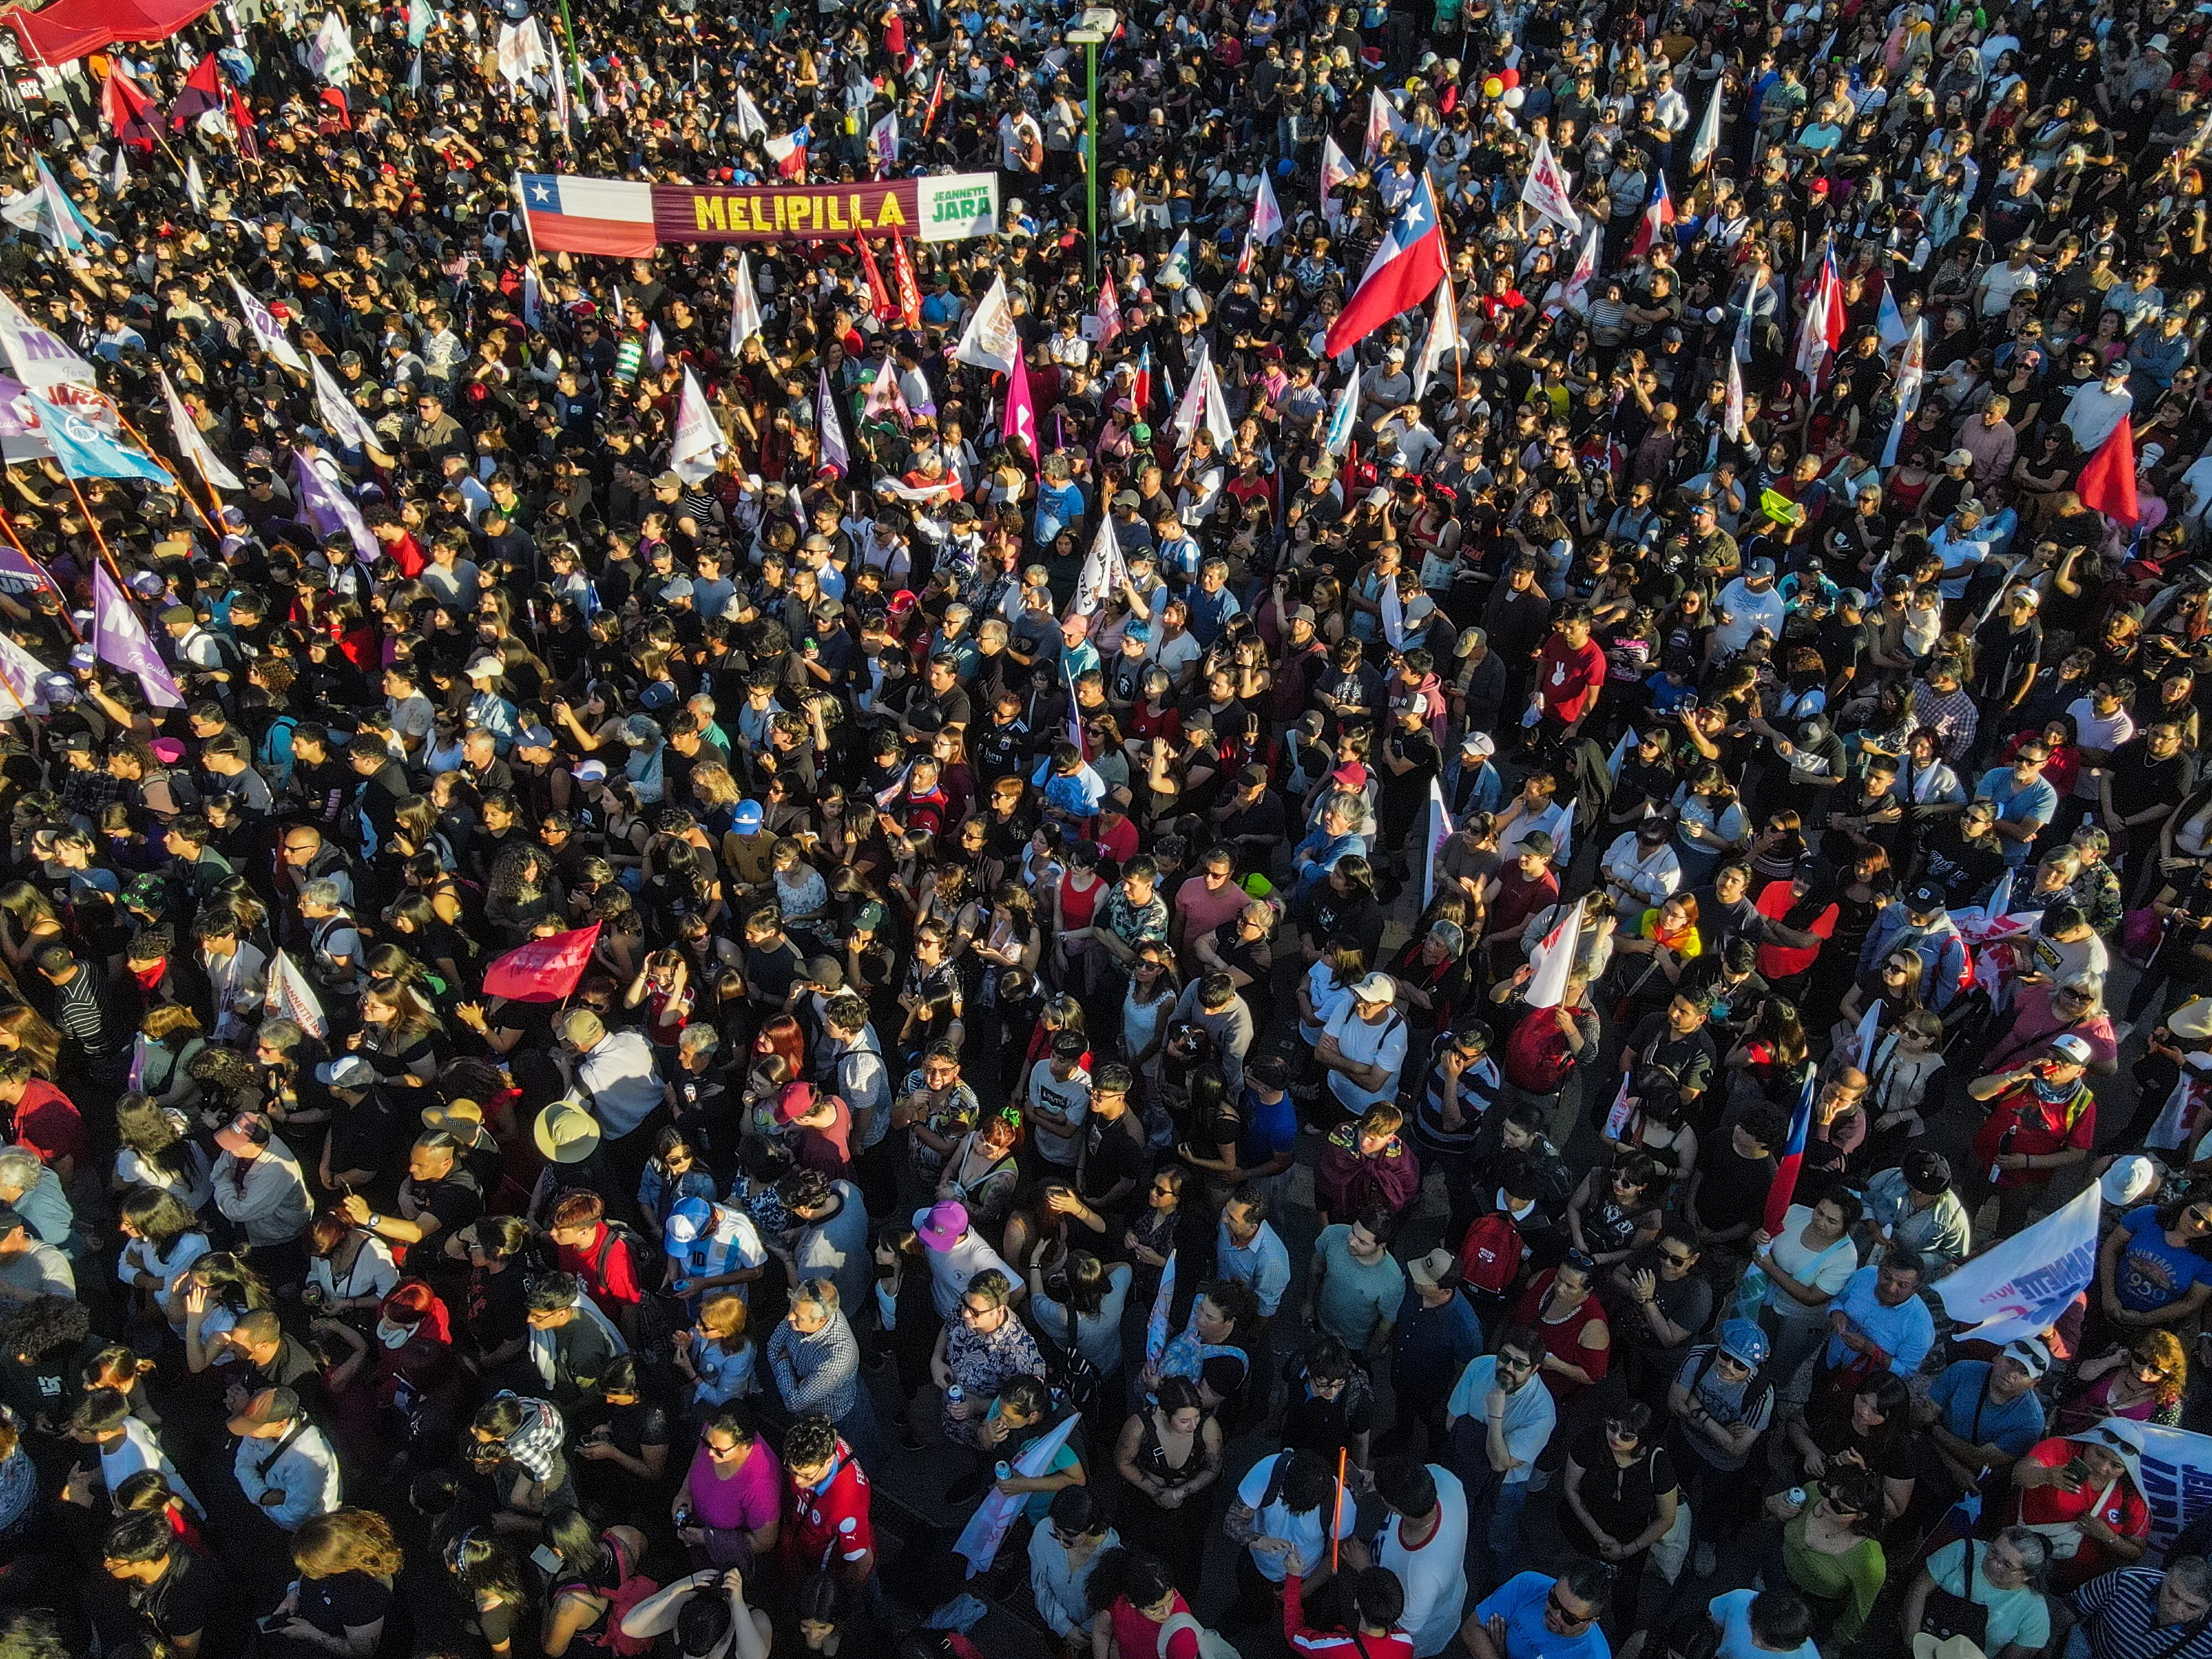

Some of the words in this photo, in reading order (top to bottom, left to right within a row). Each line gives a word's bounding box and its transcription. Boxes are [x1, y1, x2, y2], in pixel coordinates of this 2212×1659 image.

[933, 186, 988, 202] JEANNETTE
[694, 192, 906, 231] MELIPILLA
[932, 197, 992, 222] JARA
[48, 385, 108, 408] JARA
[92, 412, 101, 420] 2
[1080, 568, 1089, 599] OTA
[128, 651, 144, 666] Te
[147, 663, 169, 681] cuida
[860, 907, 870, 919] R
[692, 1251, 705, 1267] 10
[2135, 1248, 2177, 1279] VINTAGE
